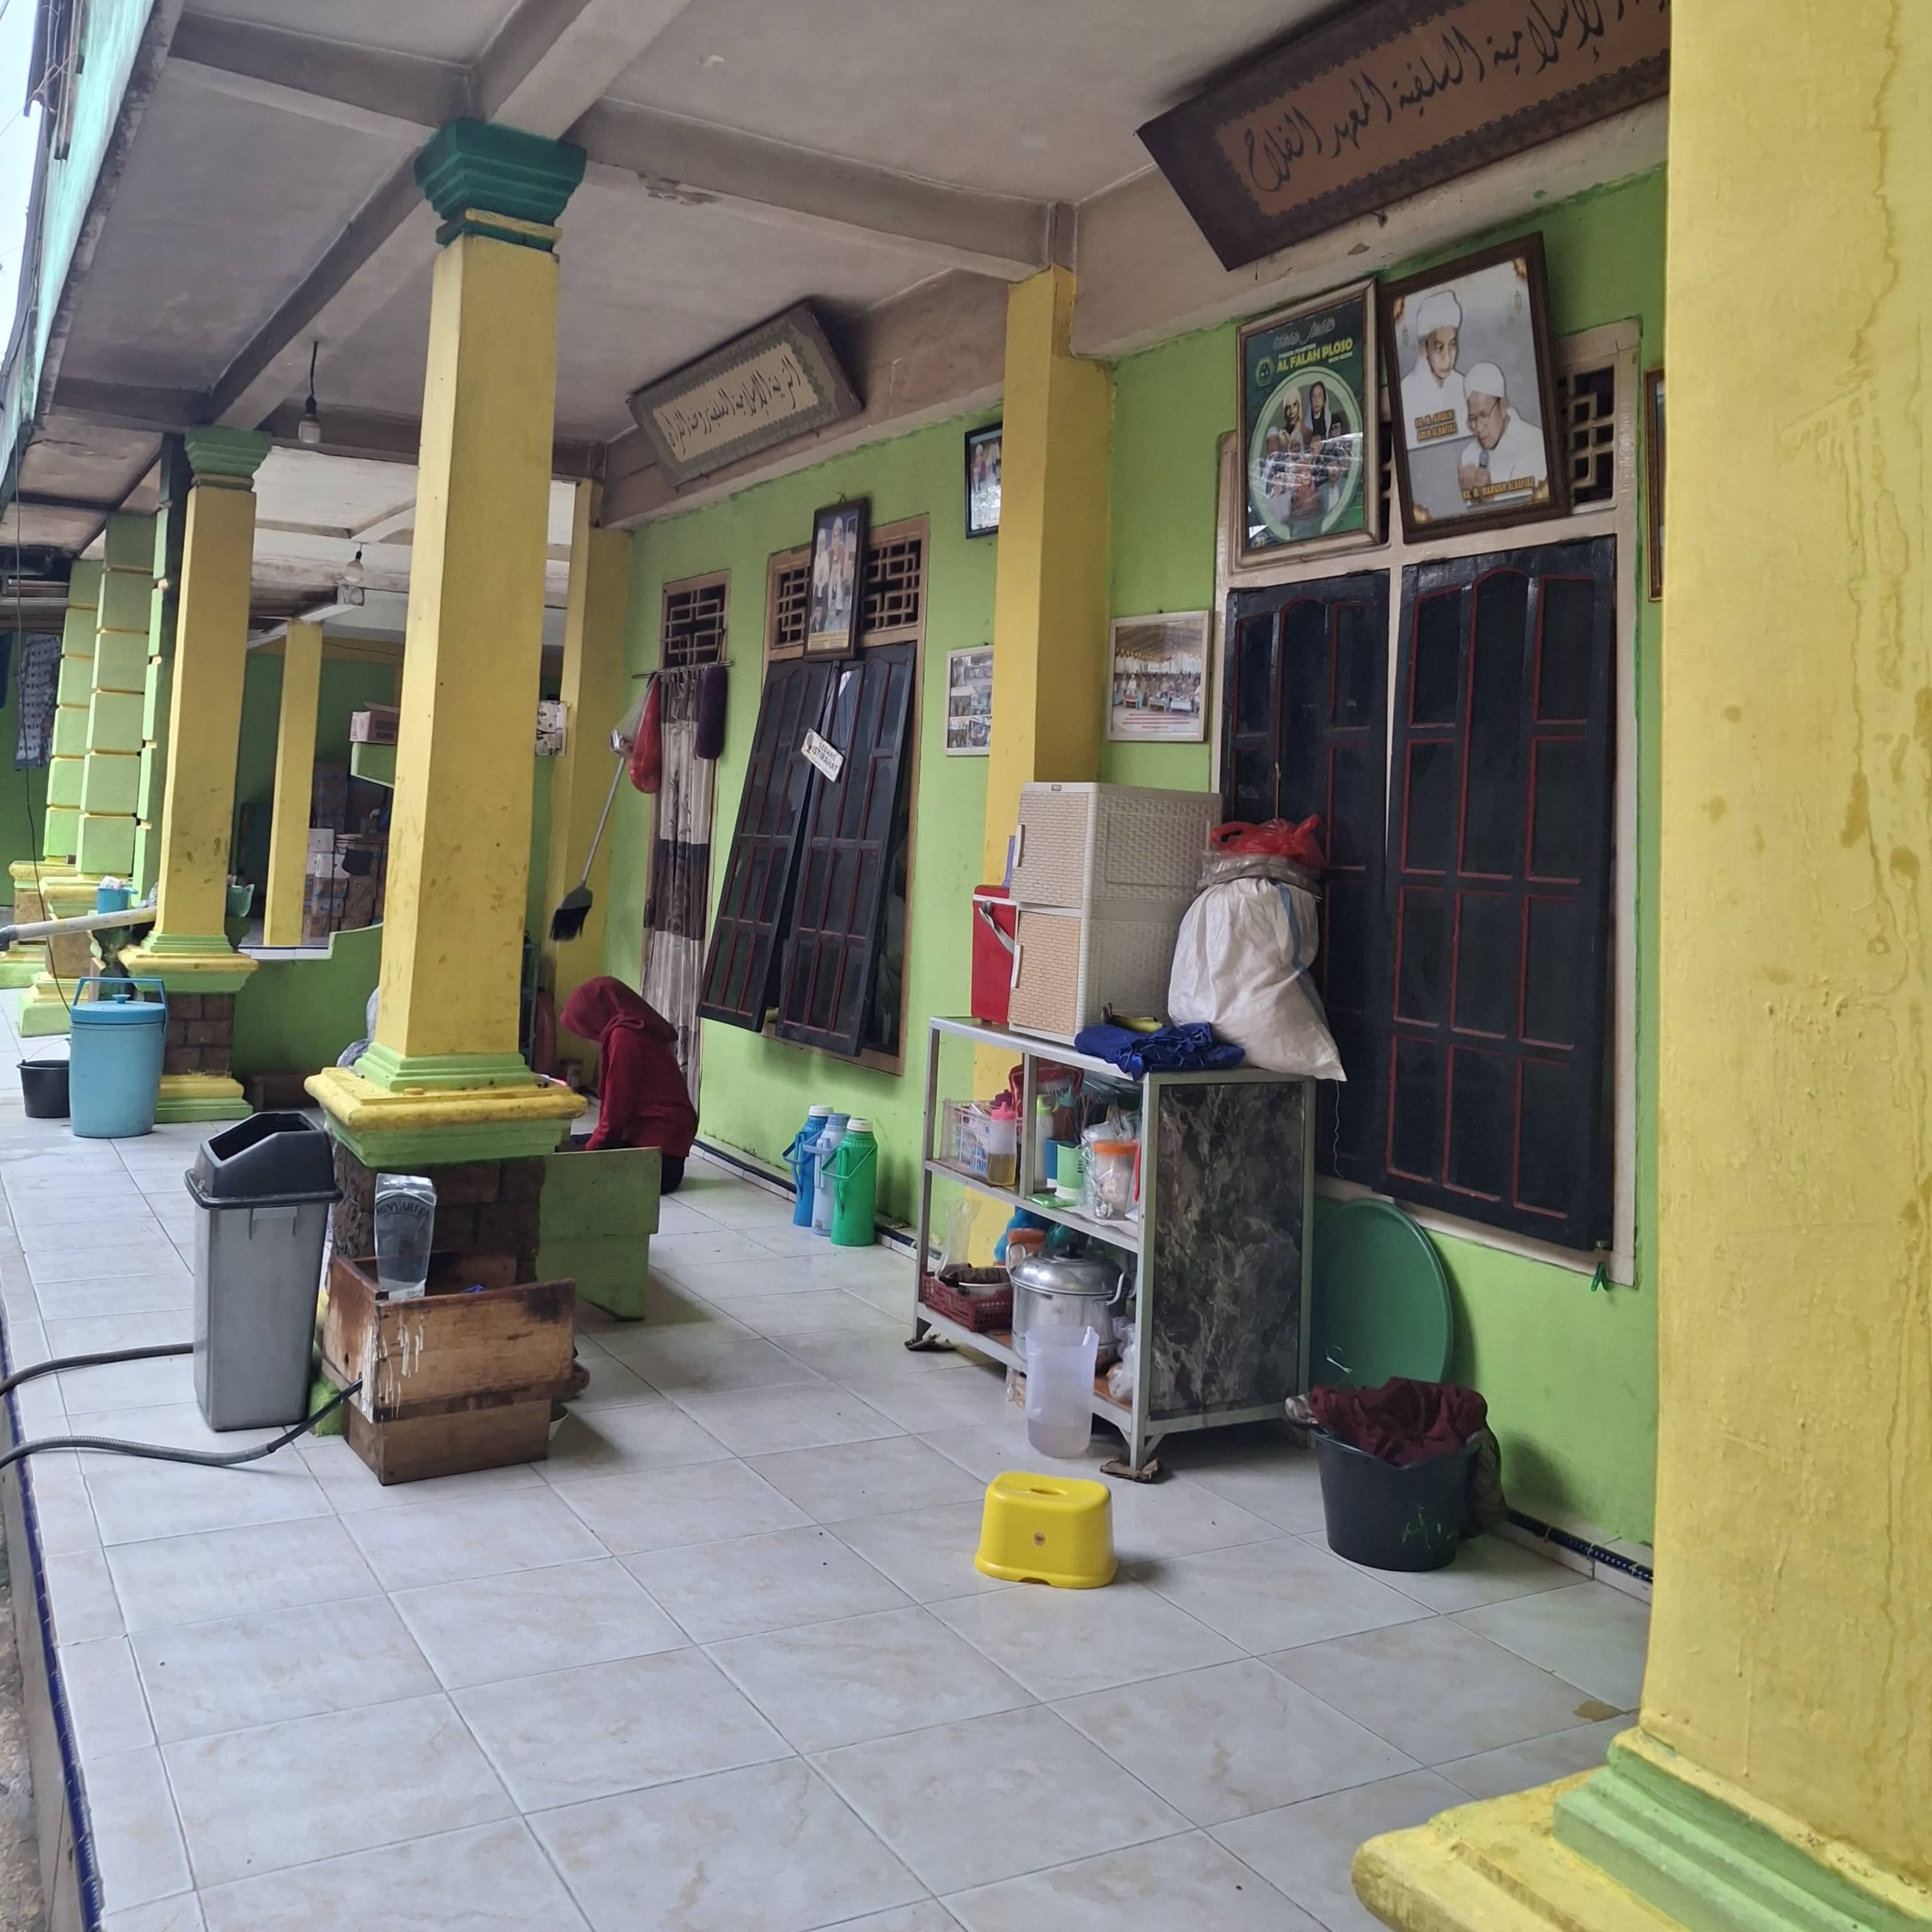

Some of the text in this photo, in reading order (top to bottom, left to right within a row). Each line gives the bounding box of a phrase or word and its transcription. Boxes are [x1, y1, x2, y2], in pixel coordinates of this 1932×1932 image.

[1277, 337, 1354, 372] AL FALAH PLOSO
[812, 745, 838, 773] ISTIRAHAT
